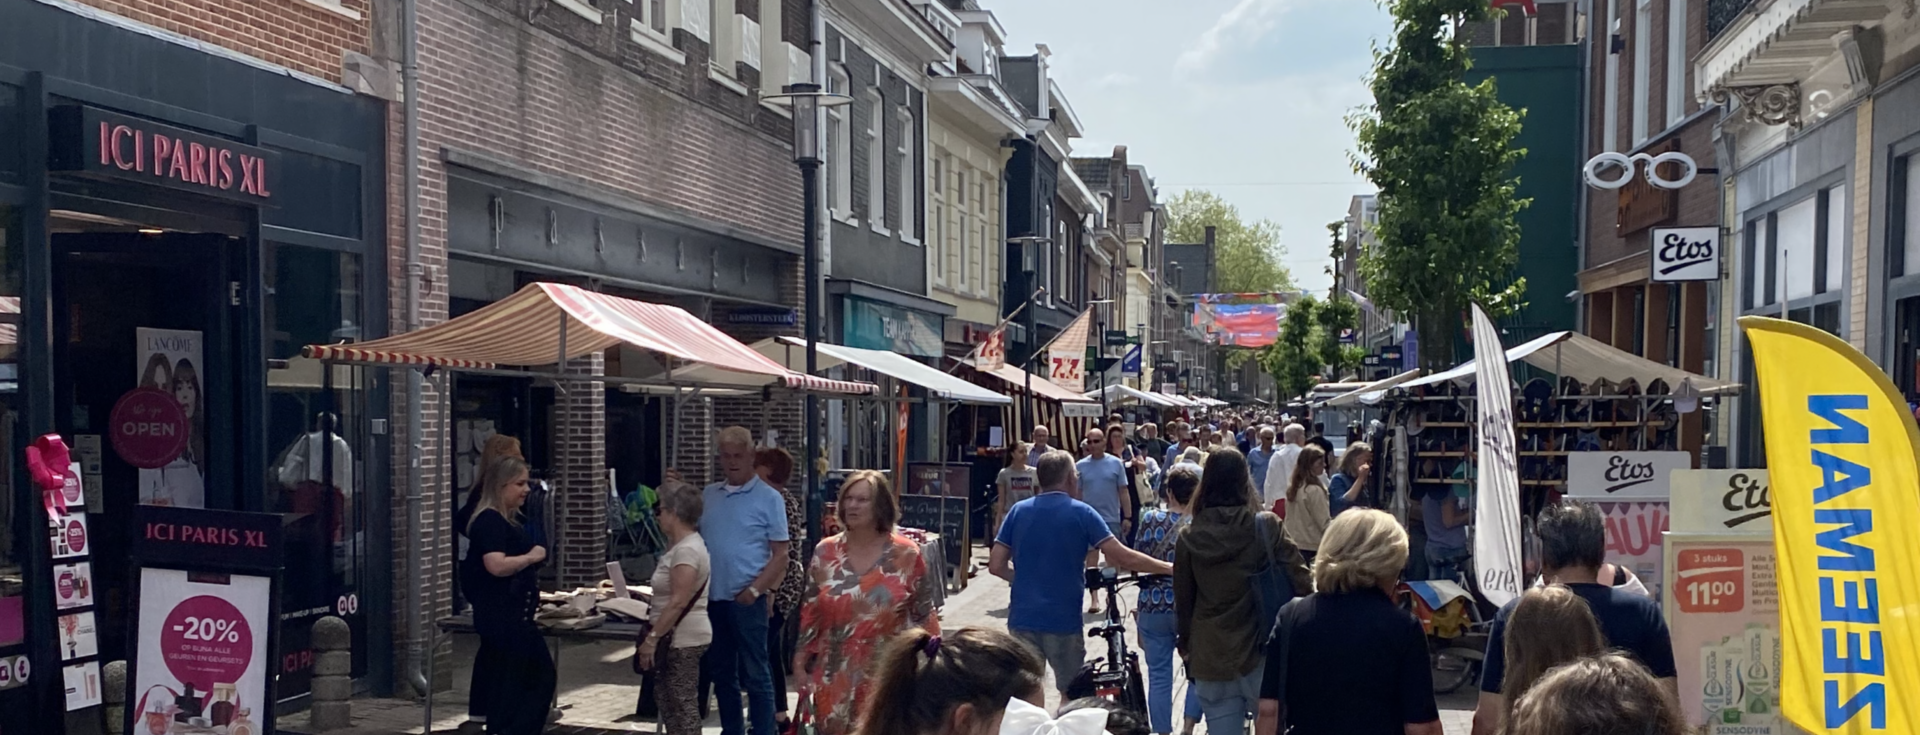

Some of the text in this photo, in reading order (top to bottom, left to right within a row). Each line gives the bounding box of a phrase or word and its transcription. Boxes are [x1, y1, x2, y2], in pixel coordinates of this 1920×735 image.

[100, 121, 270, 197] ICI PARIS XL
[1659, 233, 1713, 263] Etos
[122, 421, 175, 436] OPEN
[1604, 455, 1655, 482] Etos
[147, 522, 268, 548] ICI PARIS XL
[1694, 554, 1727, 563] 3 stuks
[168, 653, 196, 661] GEUREN
[197, 654, 207, 662] EN
[214, 646, 231, 655] ALLE
[1716, 726, 1771, 735] SENSODYNE
